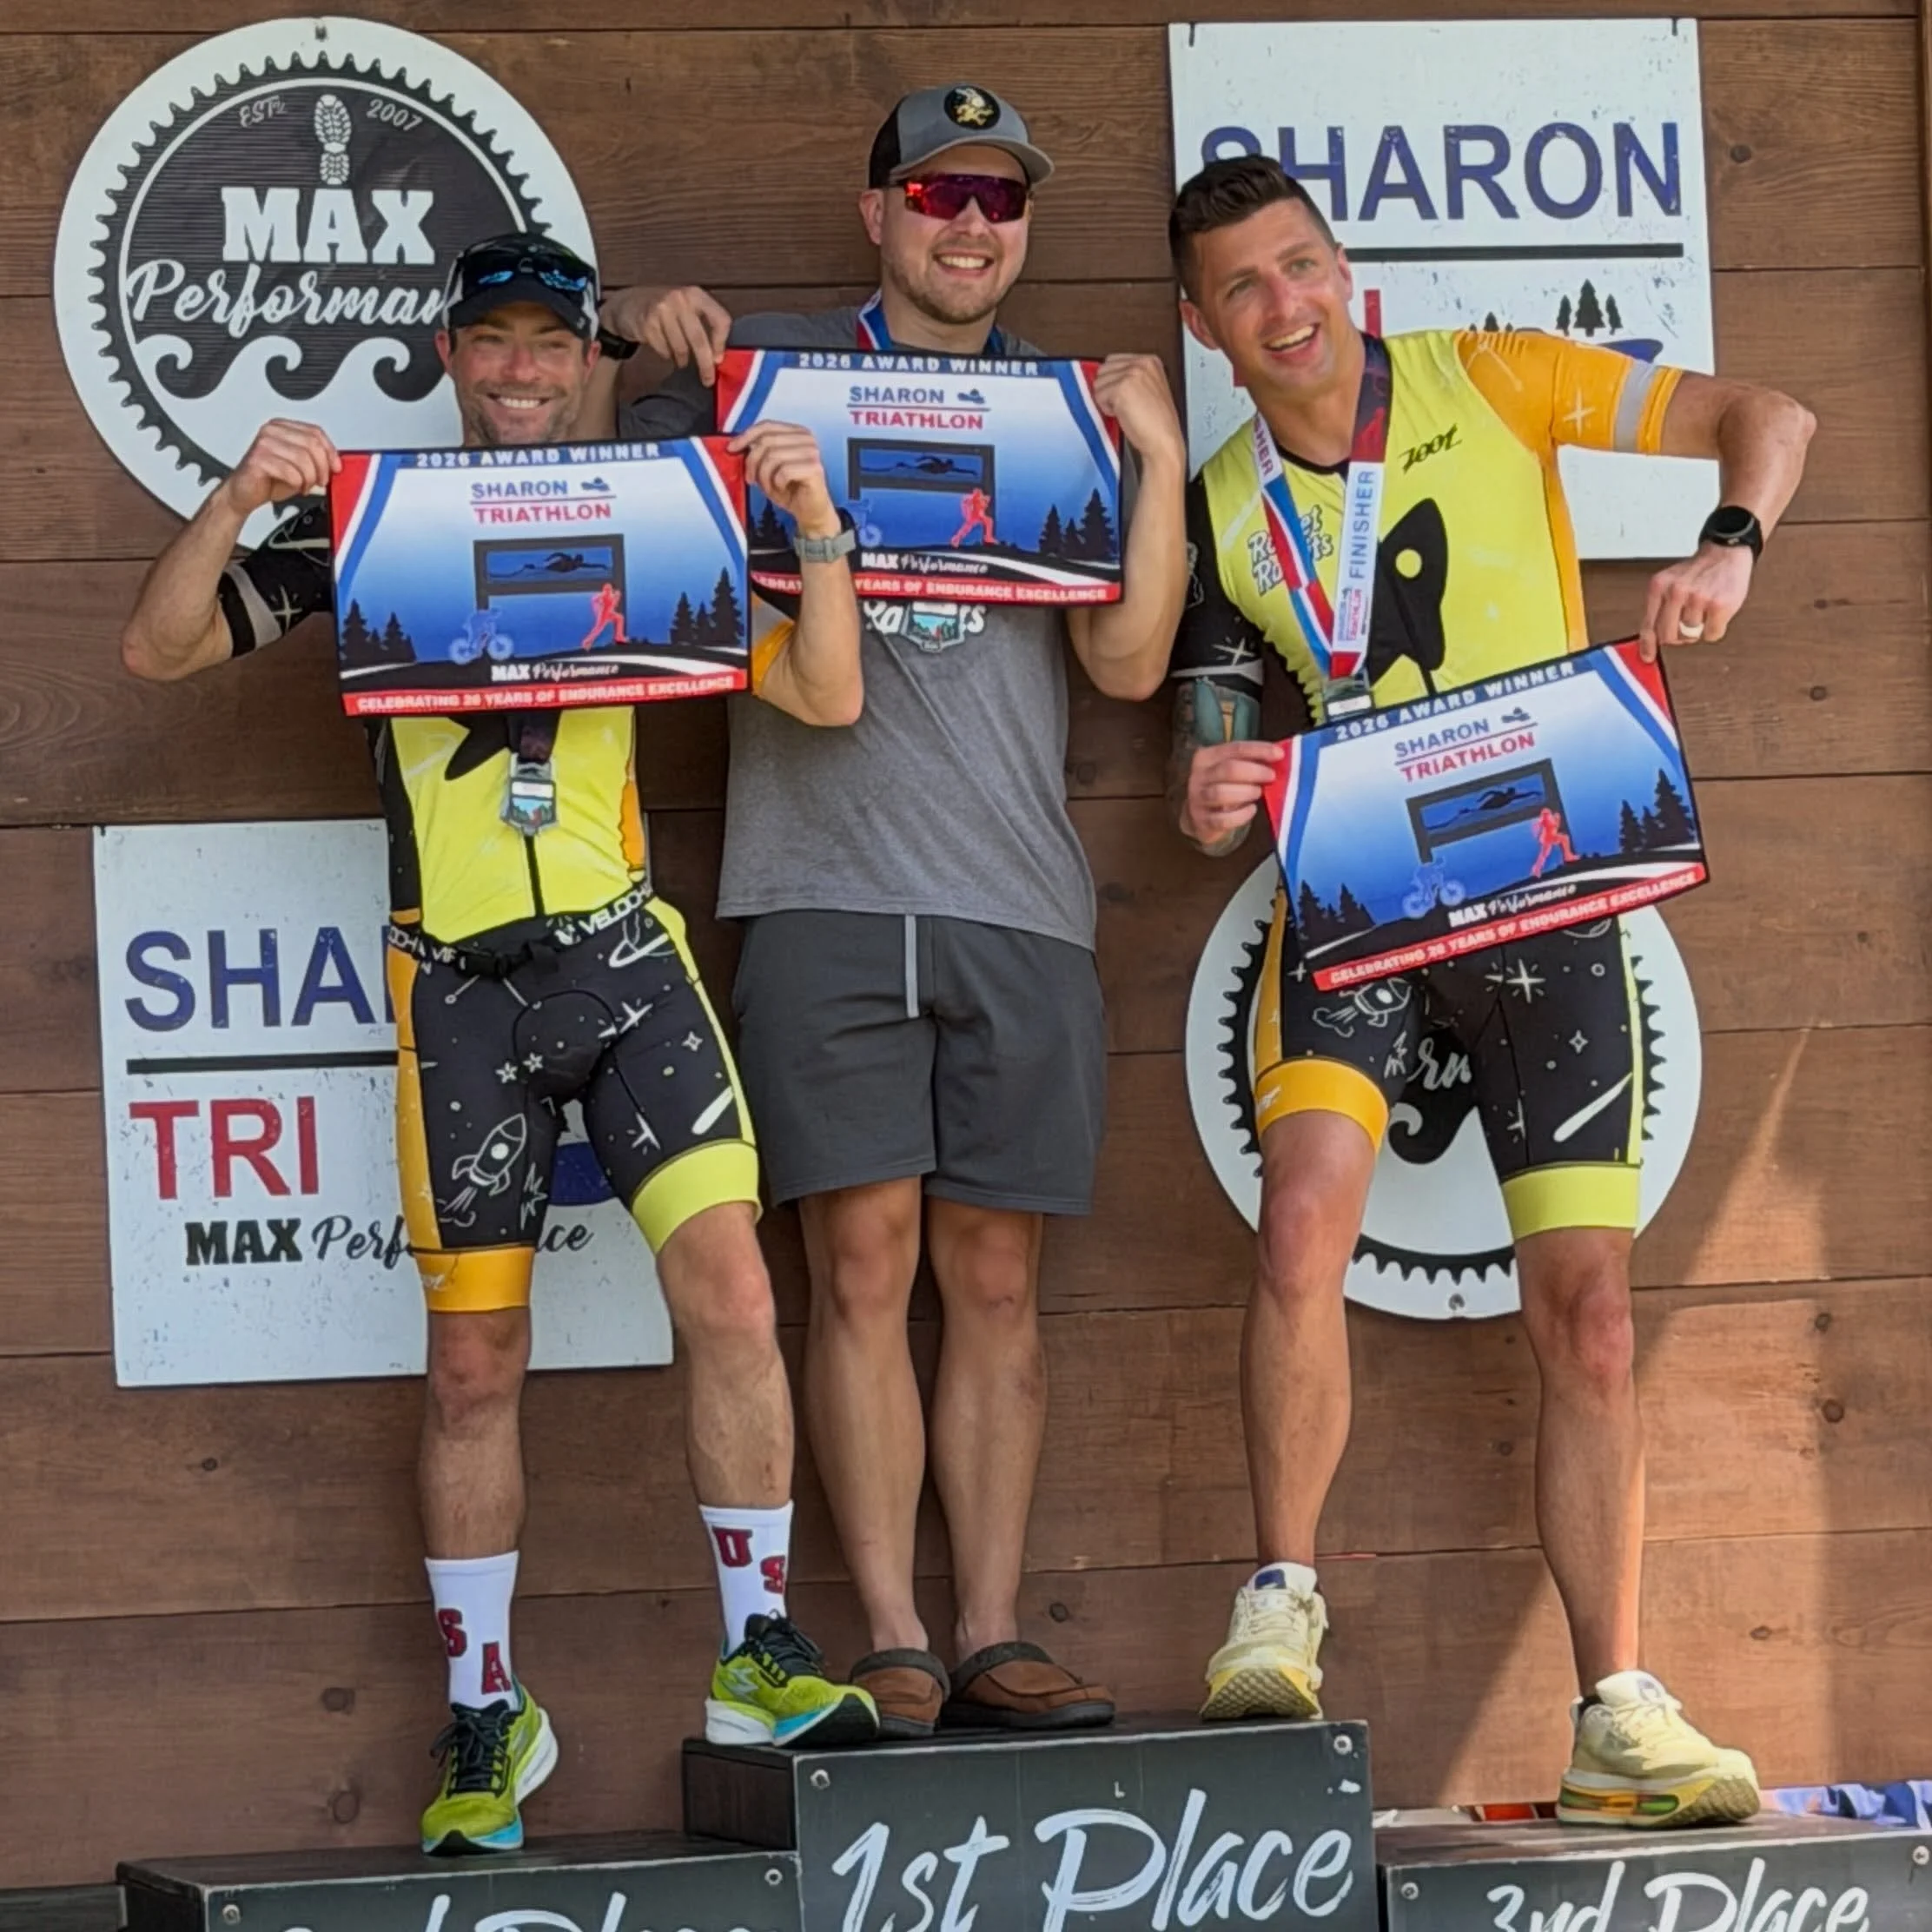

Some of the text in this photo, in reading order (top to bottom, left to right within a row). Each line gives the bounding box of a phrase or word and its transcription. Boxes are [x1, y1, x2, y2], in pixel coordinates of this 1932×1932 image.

[367, 99, 423, 130] 2007
[222, 187, 434, 264] MAX
[799, 354, 1038, 375] 2026 AWARD WINNER
[850, 386, 944, 404] SHARON
[850, 410, 983, 430] TRIATHLON
[416, 443, 660, 467] 2026 AWARD WINNER
[471, 480, 568, 498] SHARON
[473, 503, 612, 523] TRIATHLON
[1349, 470, 1375, 579] FINISHER
[862, 552, 898, 570] MAX
[855, 578, 1107, 602] YEARS OF ENDURANCE EXCELLENCE
[492, 665, 530, 681] MAX
[357, 694, 460, 711] CELEBRATING
[485, 691, 533, 707] YEARS
[536, 689, 554, 704] OF
[559, 683, 645, 702] ENDURANCE
[648, 676, 733, 695] EXCELLENCE
[1335, 662, 1575, 740] 2026 AWARD WINNER
[1394, 718, 1490, 758] SHARON
[1399, 732, 1536, 783] TRIATHLON
[1331, 949, 1426, 984] CELEBRATING
[1448, 929, 1496, 951] YEARS
[1498, 923, 1516, 938] OF
[1519, 898, 1607, 932] ENDURANCE
[1610, 871, 1697, 907] EXCELLENCE
[1448, 903, 1487, 928] MAX
[125, 925, 397, 1032] SHA
[129, 1095, 319, 1200] TRI
[185, 1218, 302, 1266] MAX
[831, 1789, 1353, 1932] 1st Place
[1644, 1856, 1871, 1932] Place
